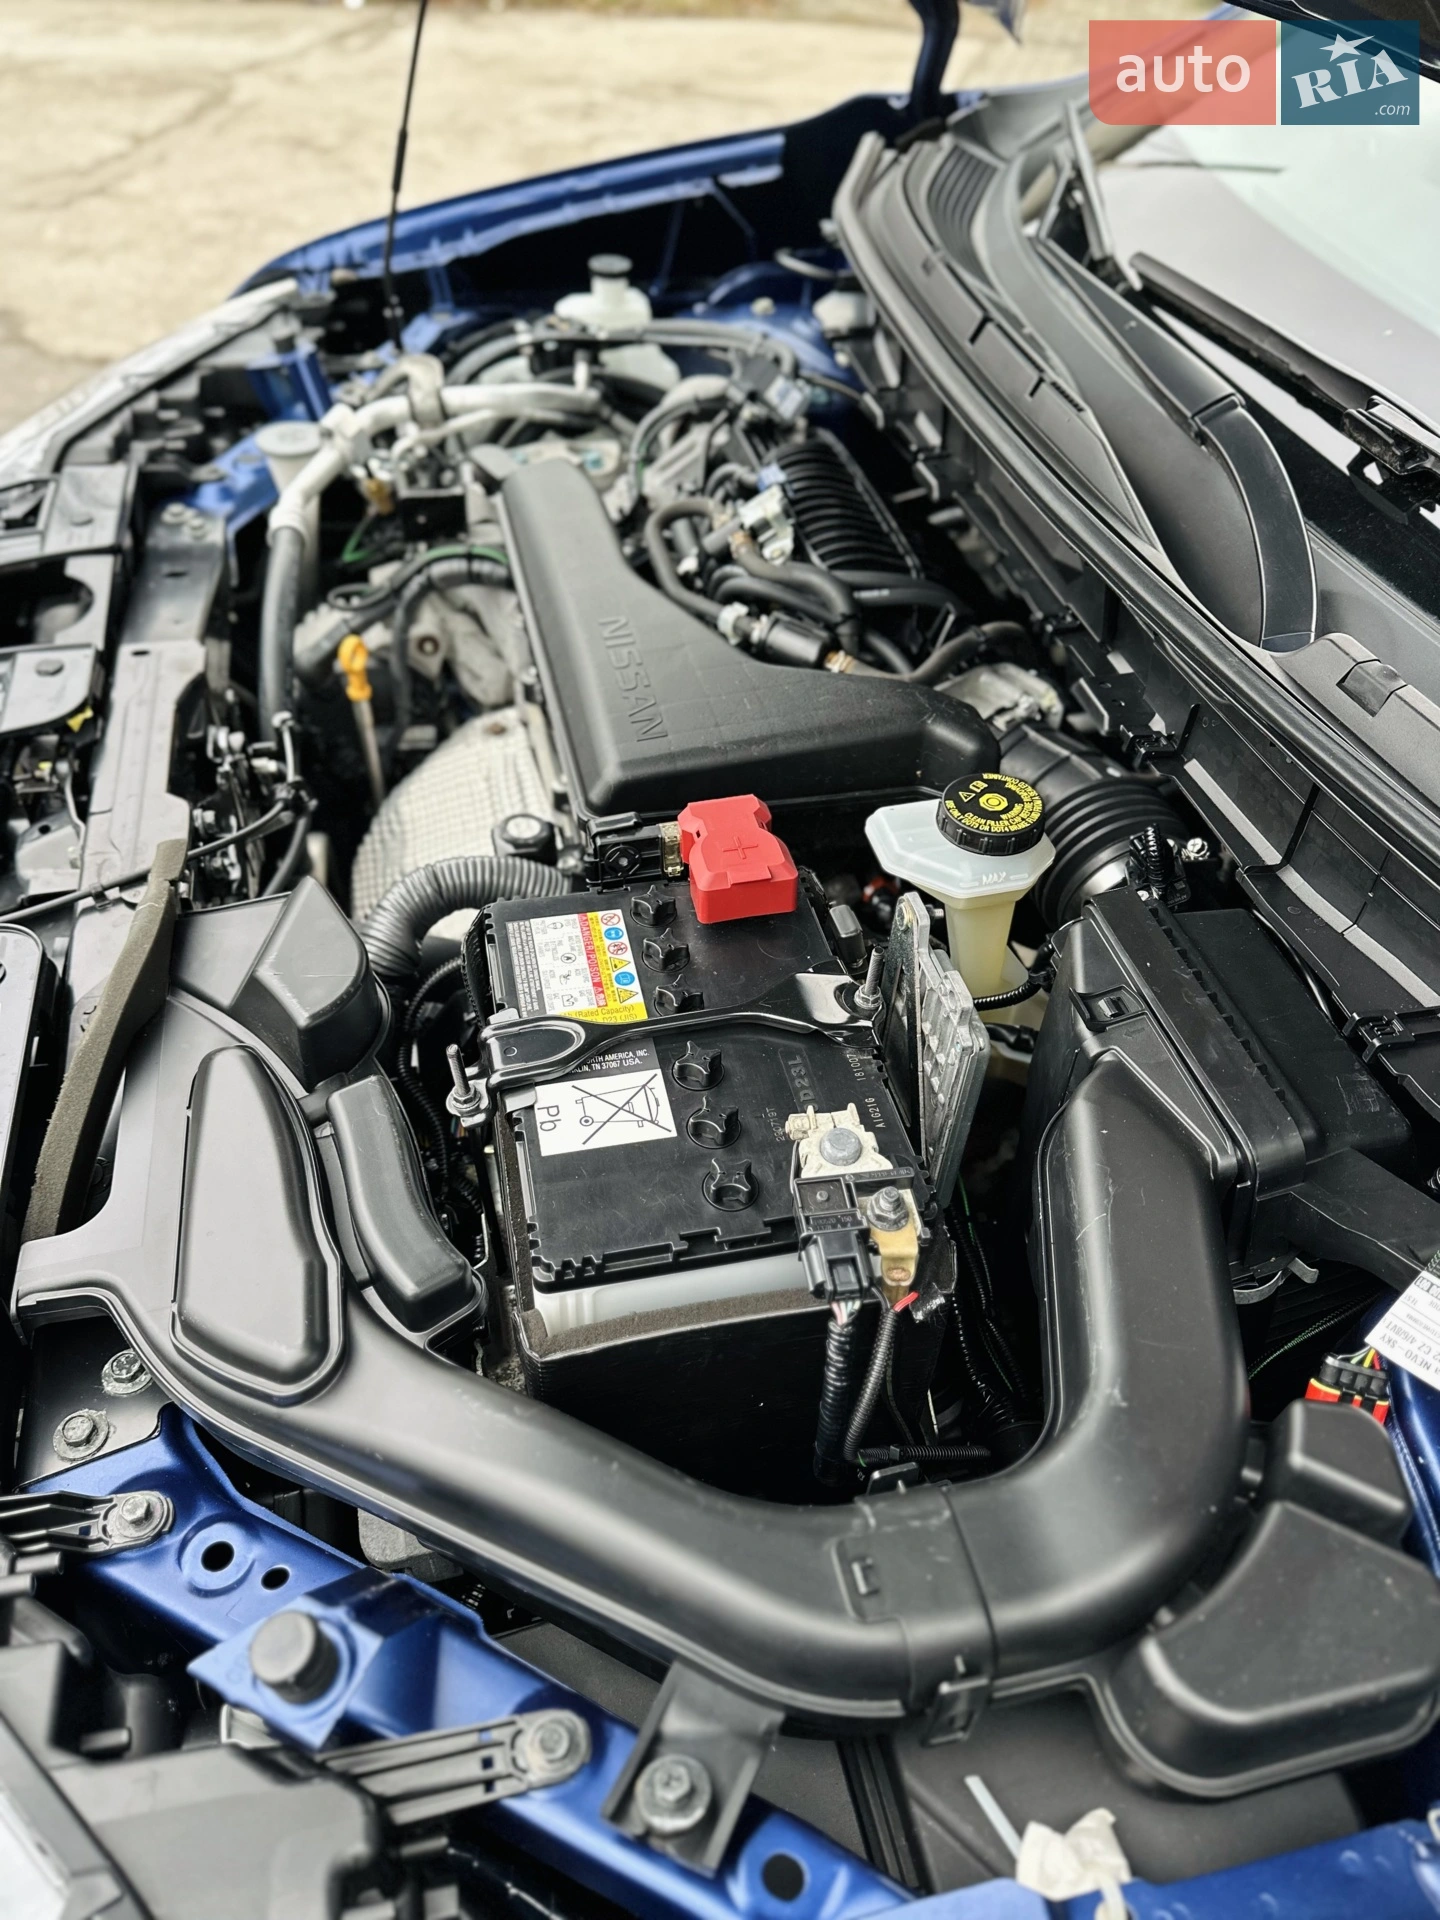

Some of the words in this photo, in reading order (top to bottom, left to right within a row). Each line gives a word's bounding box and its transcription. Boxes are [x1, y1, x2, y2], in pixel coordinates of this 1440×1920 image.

[598, 615, 669, 742] NISSAN
[986, 820, 1010, 828] FILLER
[982, 872, 1006, 886] MAX
[575, 1010, 600, 1018] (Rated
[601, 1005, 634, 1016] Capacity)
[604, 1051, 635, 1062] AMERICA,
[636, 1049, 649, 1057] INC.
[591, 1063, 600, 1071] TN
[622, 1058, 643, 1067] USA.
[537, 1104, 562, 1132] Pb
[1379, 1333, 1398, 1349] SKY
